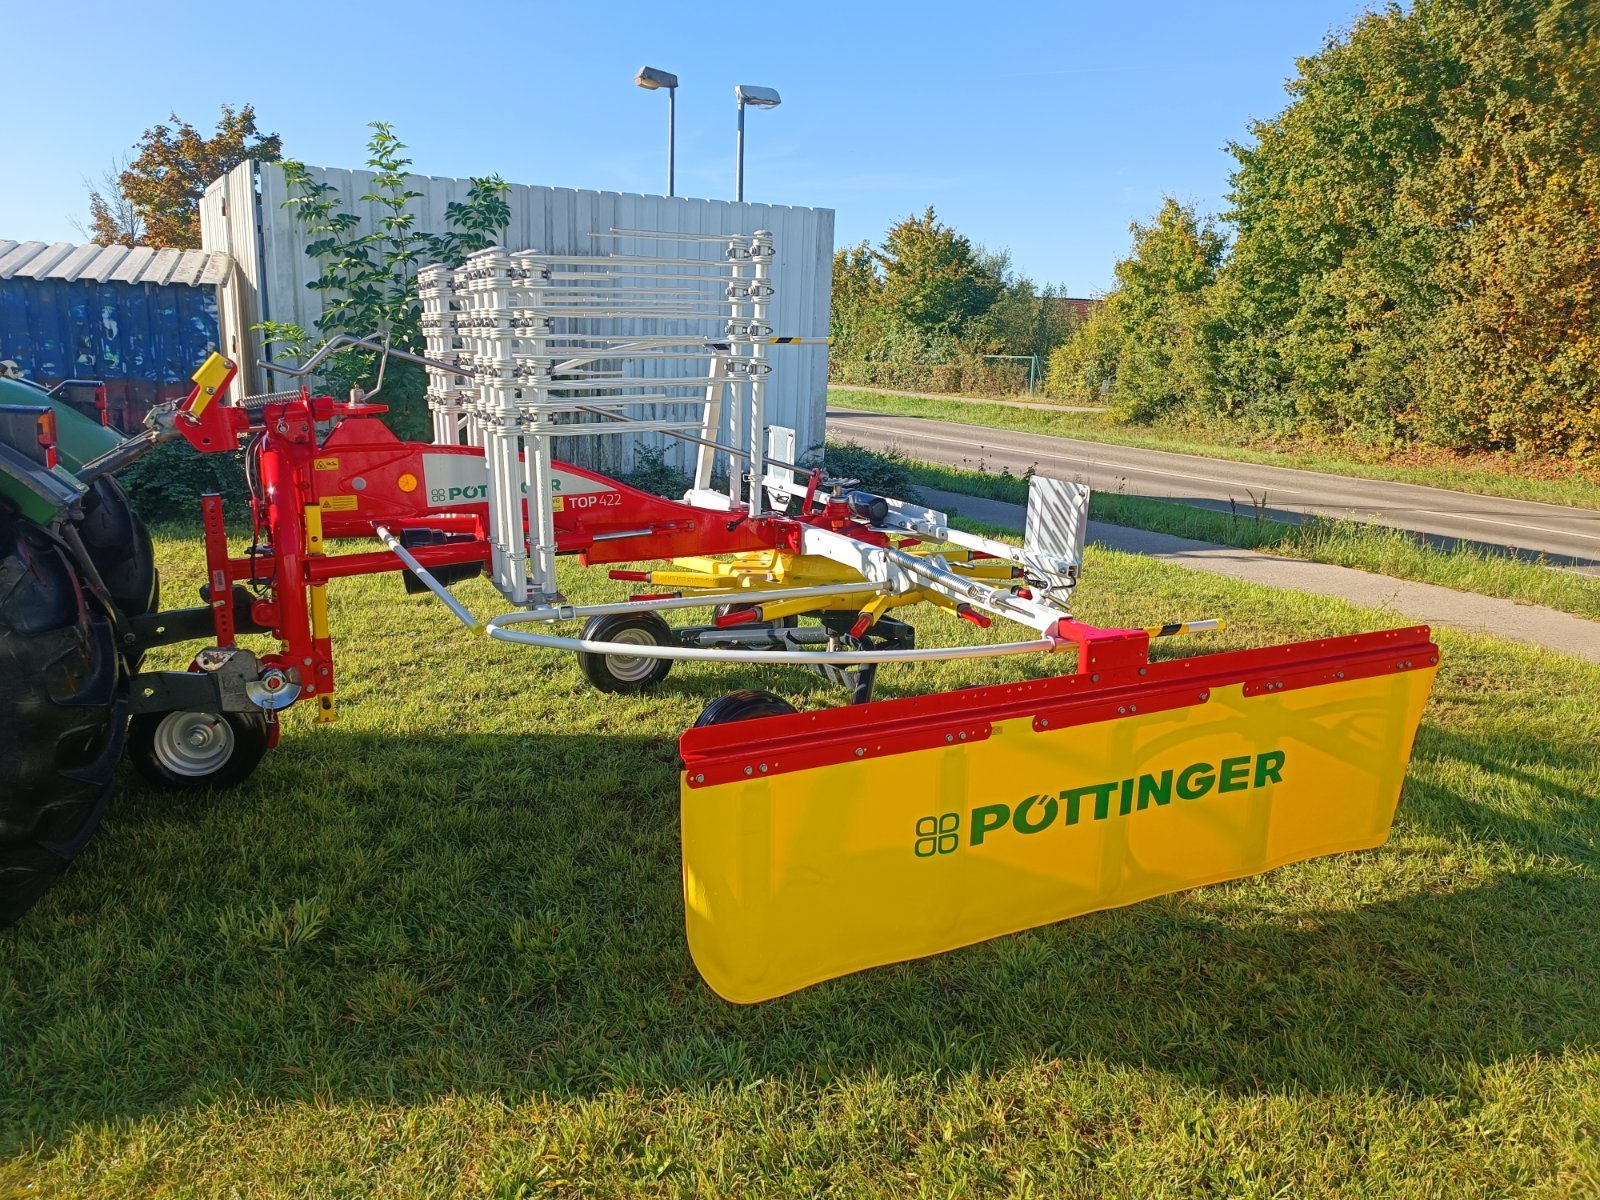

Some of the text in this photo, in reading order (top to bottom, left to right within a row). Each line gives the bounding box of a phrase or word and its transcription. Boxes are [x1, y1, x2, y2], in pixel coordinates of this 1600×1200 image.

[569, 494, 622, 509] TOP 422
[970, 750, 1286, 846] PÖTTINGER
